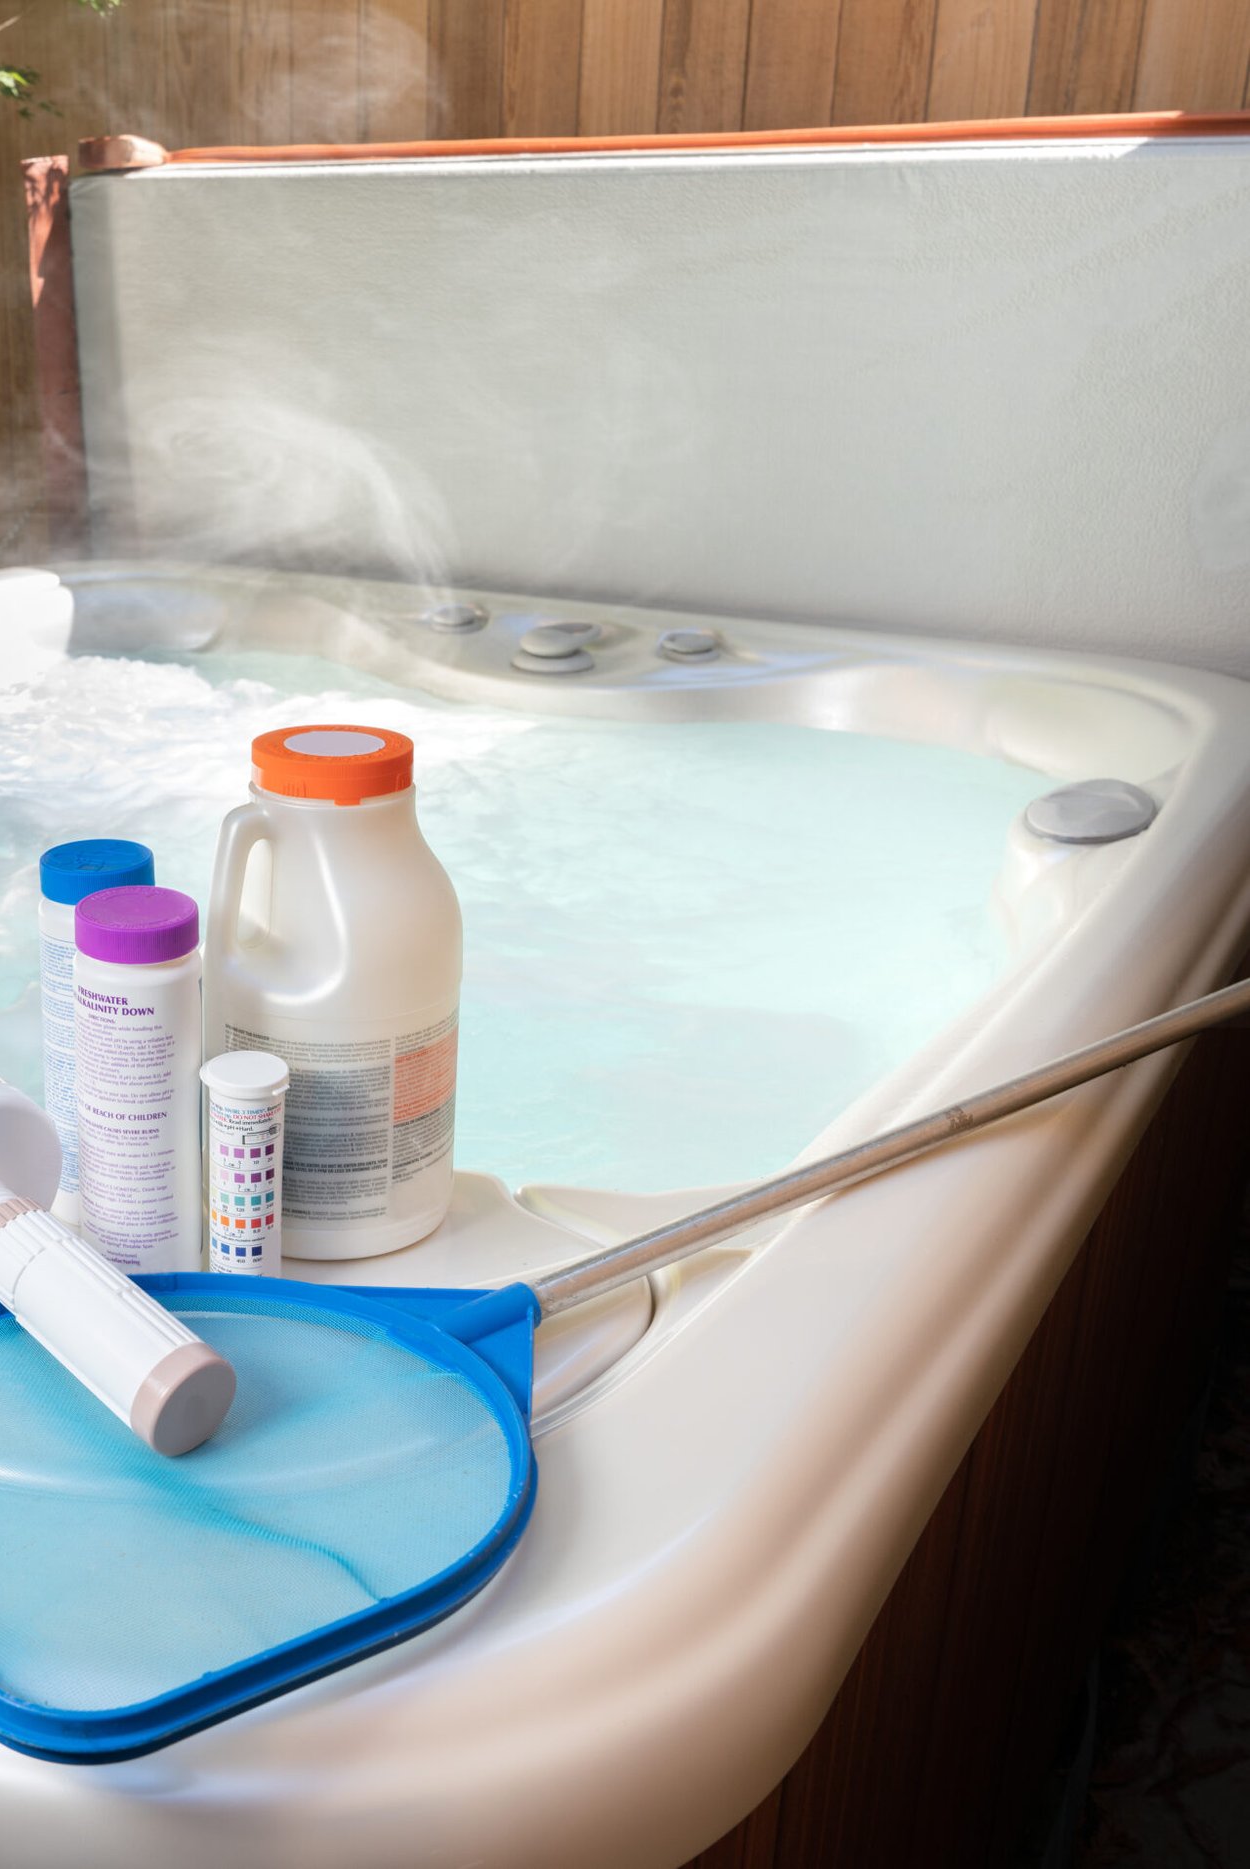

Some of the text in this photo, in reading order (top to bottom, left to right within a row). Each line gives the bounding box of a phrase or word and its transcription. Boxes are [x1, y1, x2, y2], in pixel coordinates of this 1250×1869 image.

[122, 1007, 155, 1017] DOWN
[92, 1107, 114, 1119] REACH
[115, 1112, 127, 1121] OF
[128, 1111, 168, 1122] CHILDREN
